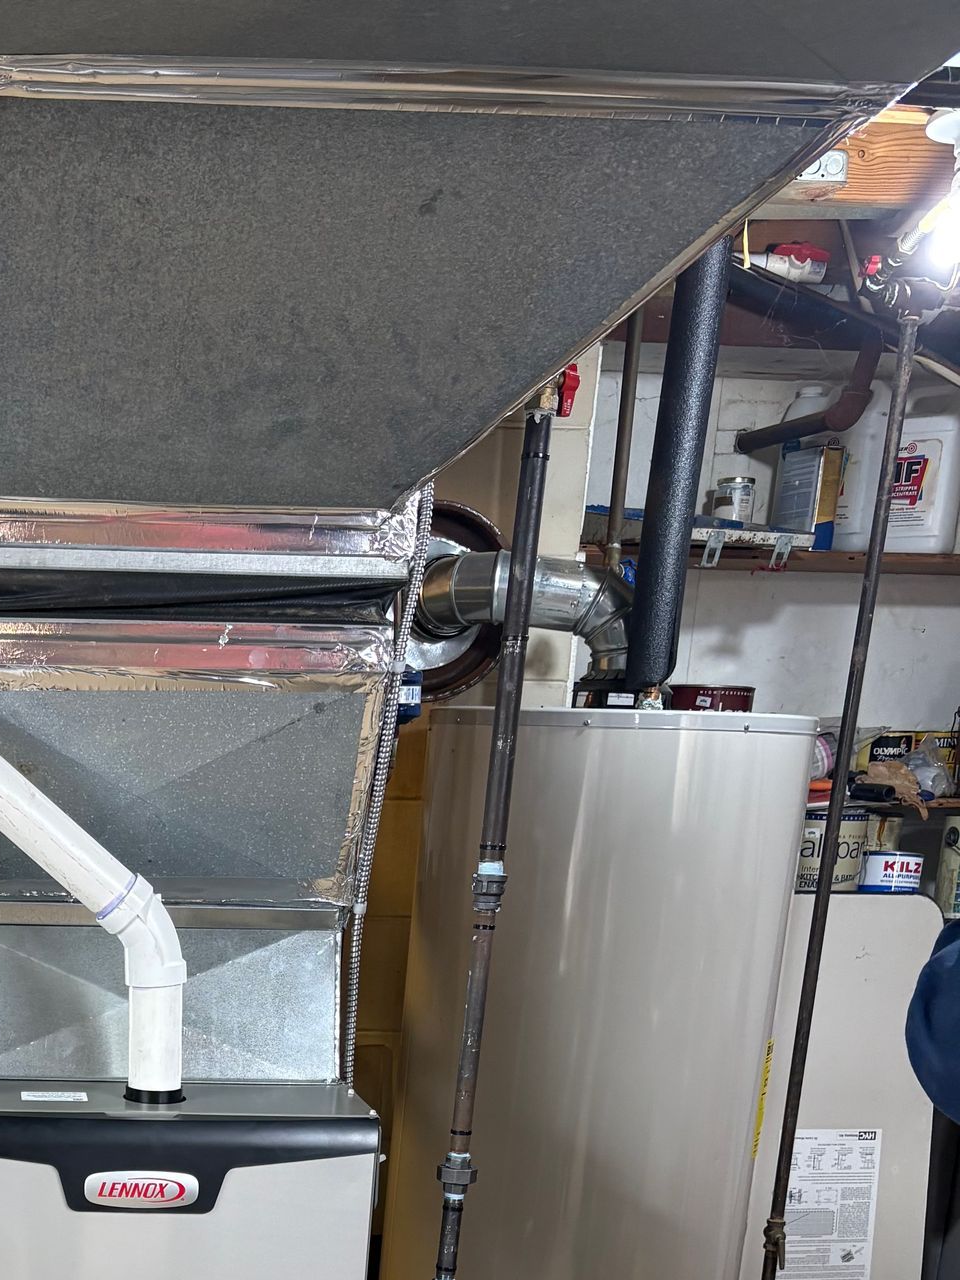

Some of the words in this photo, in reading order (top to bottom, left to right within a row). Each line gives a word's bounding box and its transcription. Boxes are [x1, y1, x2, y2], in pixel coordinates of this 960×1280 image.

[873, 747, 908, 756] OLYMPIC
[883, 860, 922, 874] KILZ
[97, 1181, 169, 1199] LENNOX
